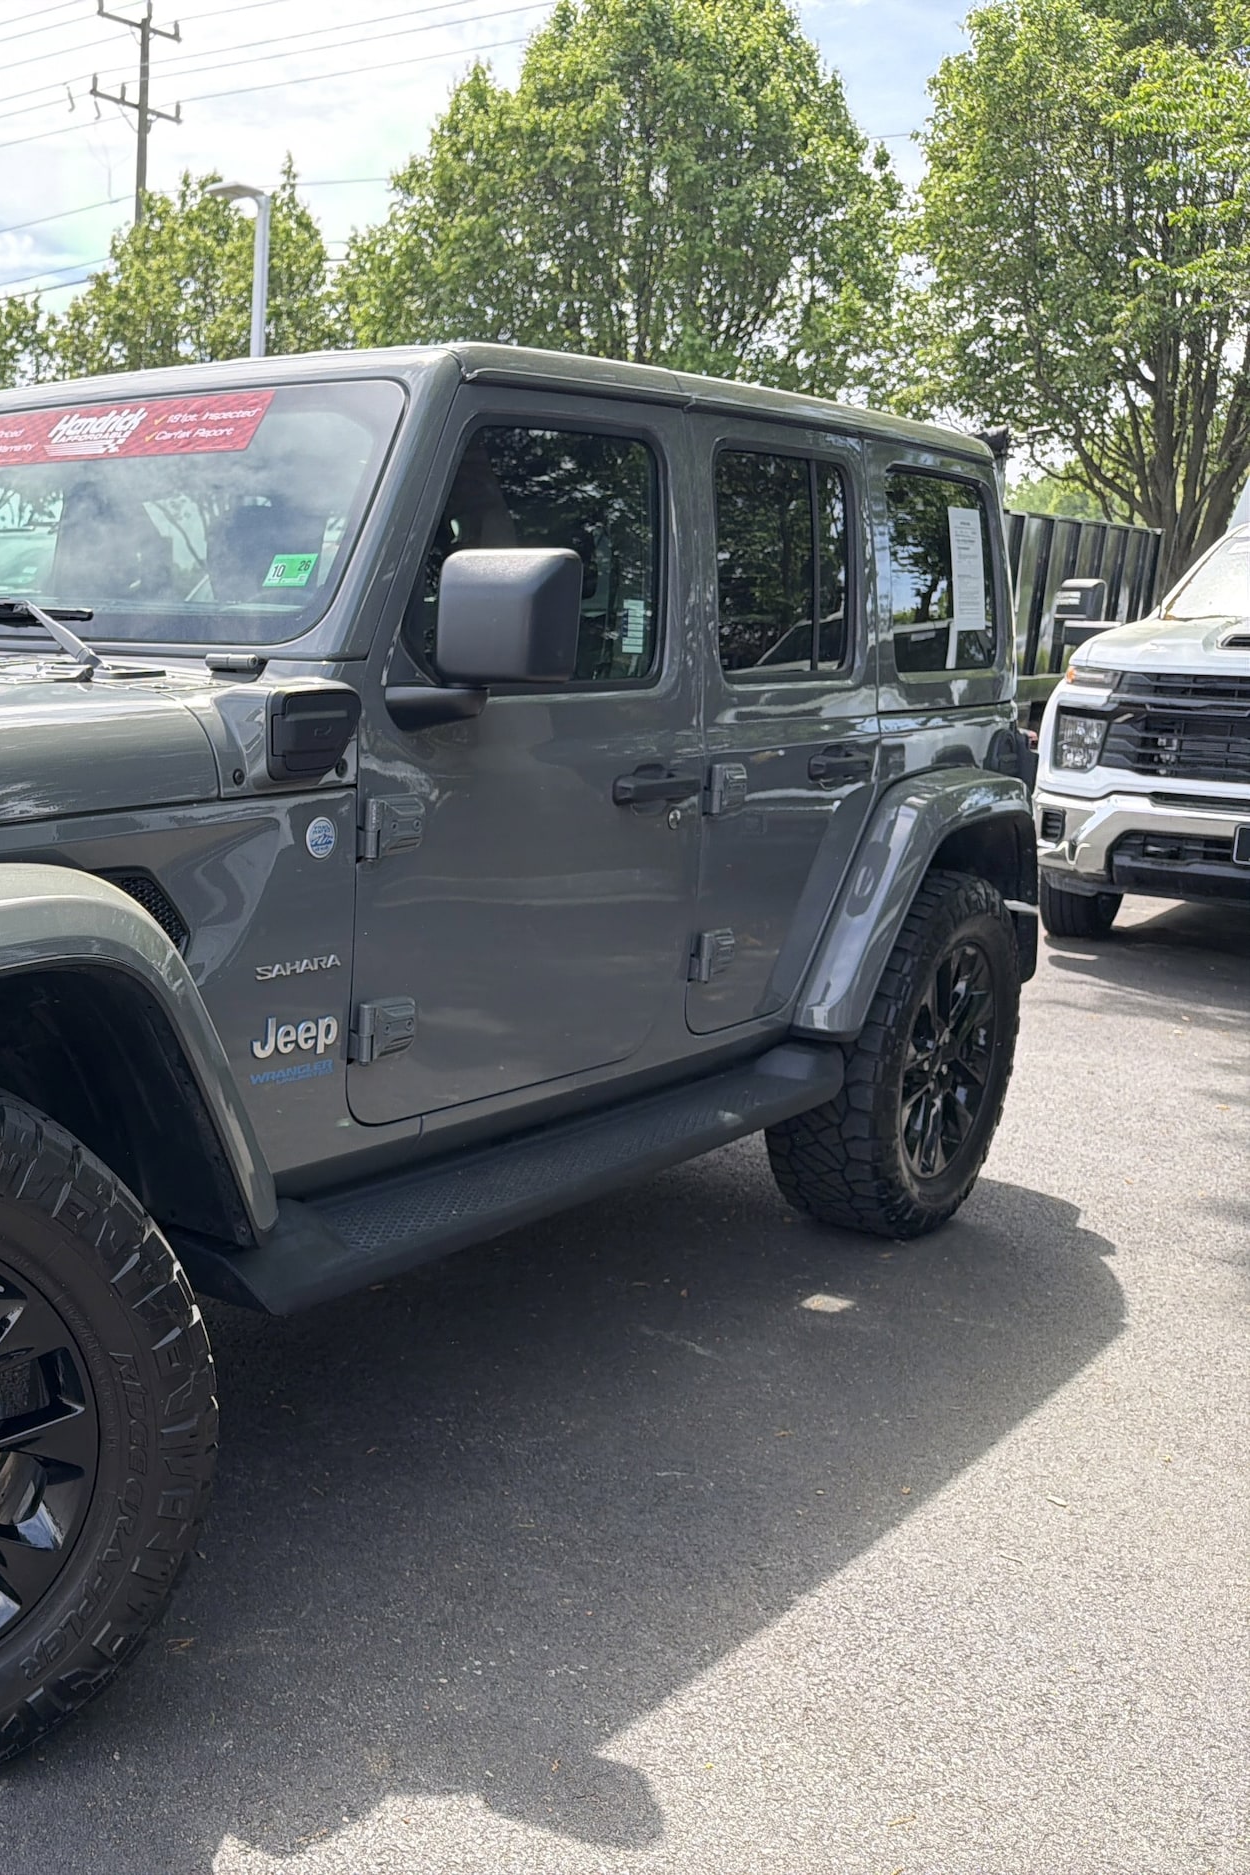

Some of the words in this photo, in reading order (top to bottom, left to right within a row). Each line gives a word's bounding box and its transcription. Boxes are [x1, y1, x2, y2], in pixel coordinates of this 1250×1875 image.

[47, 407, 148, 444] Hendrick
[272, 564, 287, 578] 10
[255, 954, 341, 981] SAHARA
[252, 1015, 338, 1059] Jeep
[250, 1059, 333, 1085] WRANGLER
